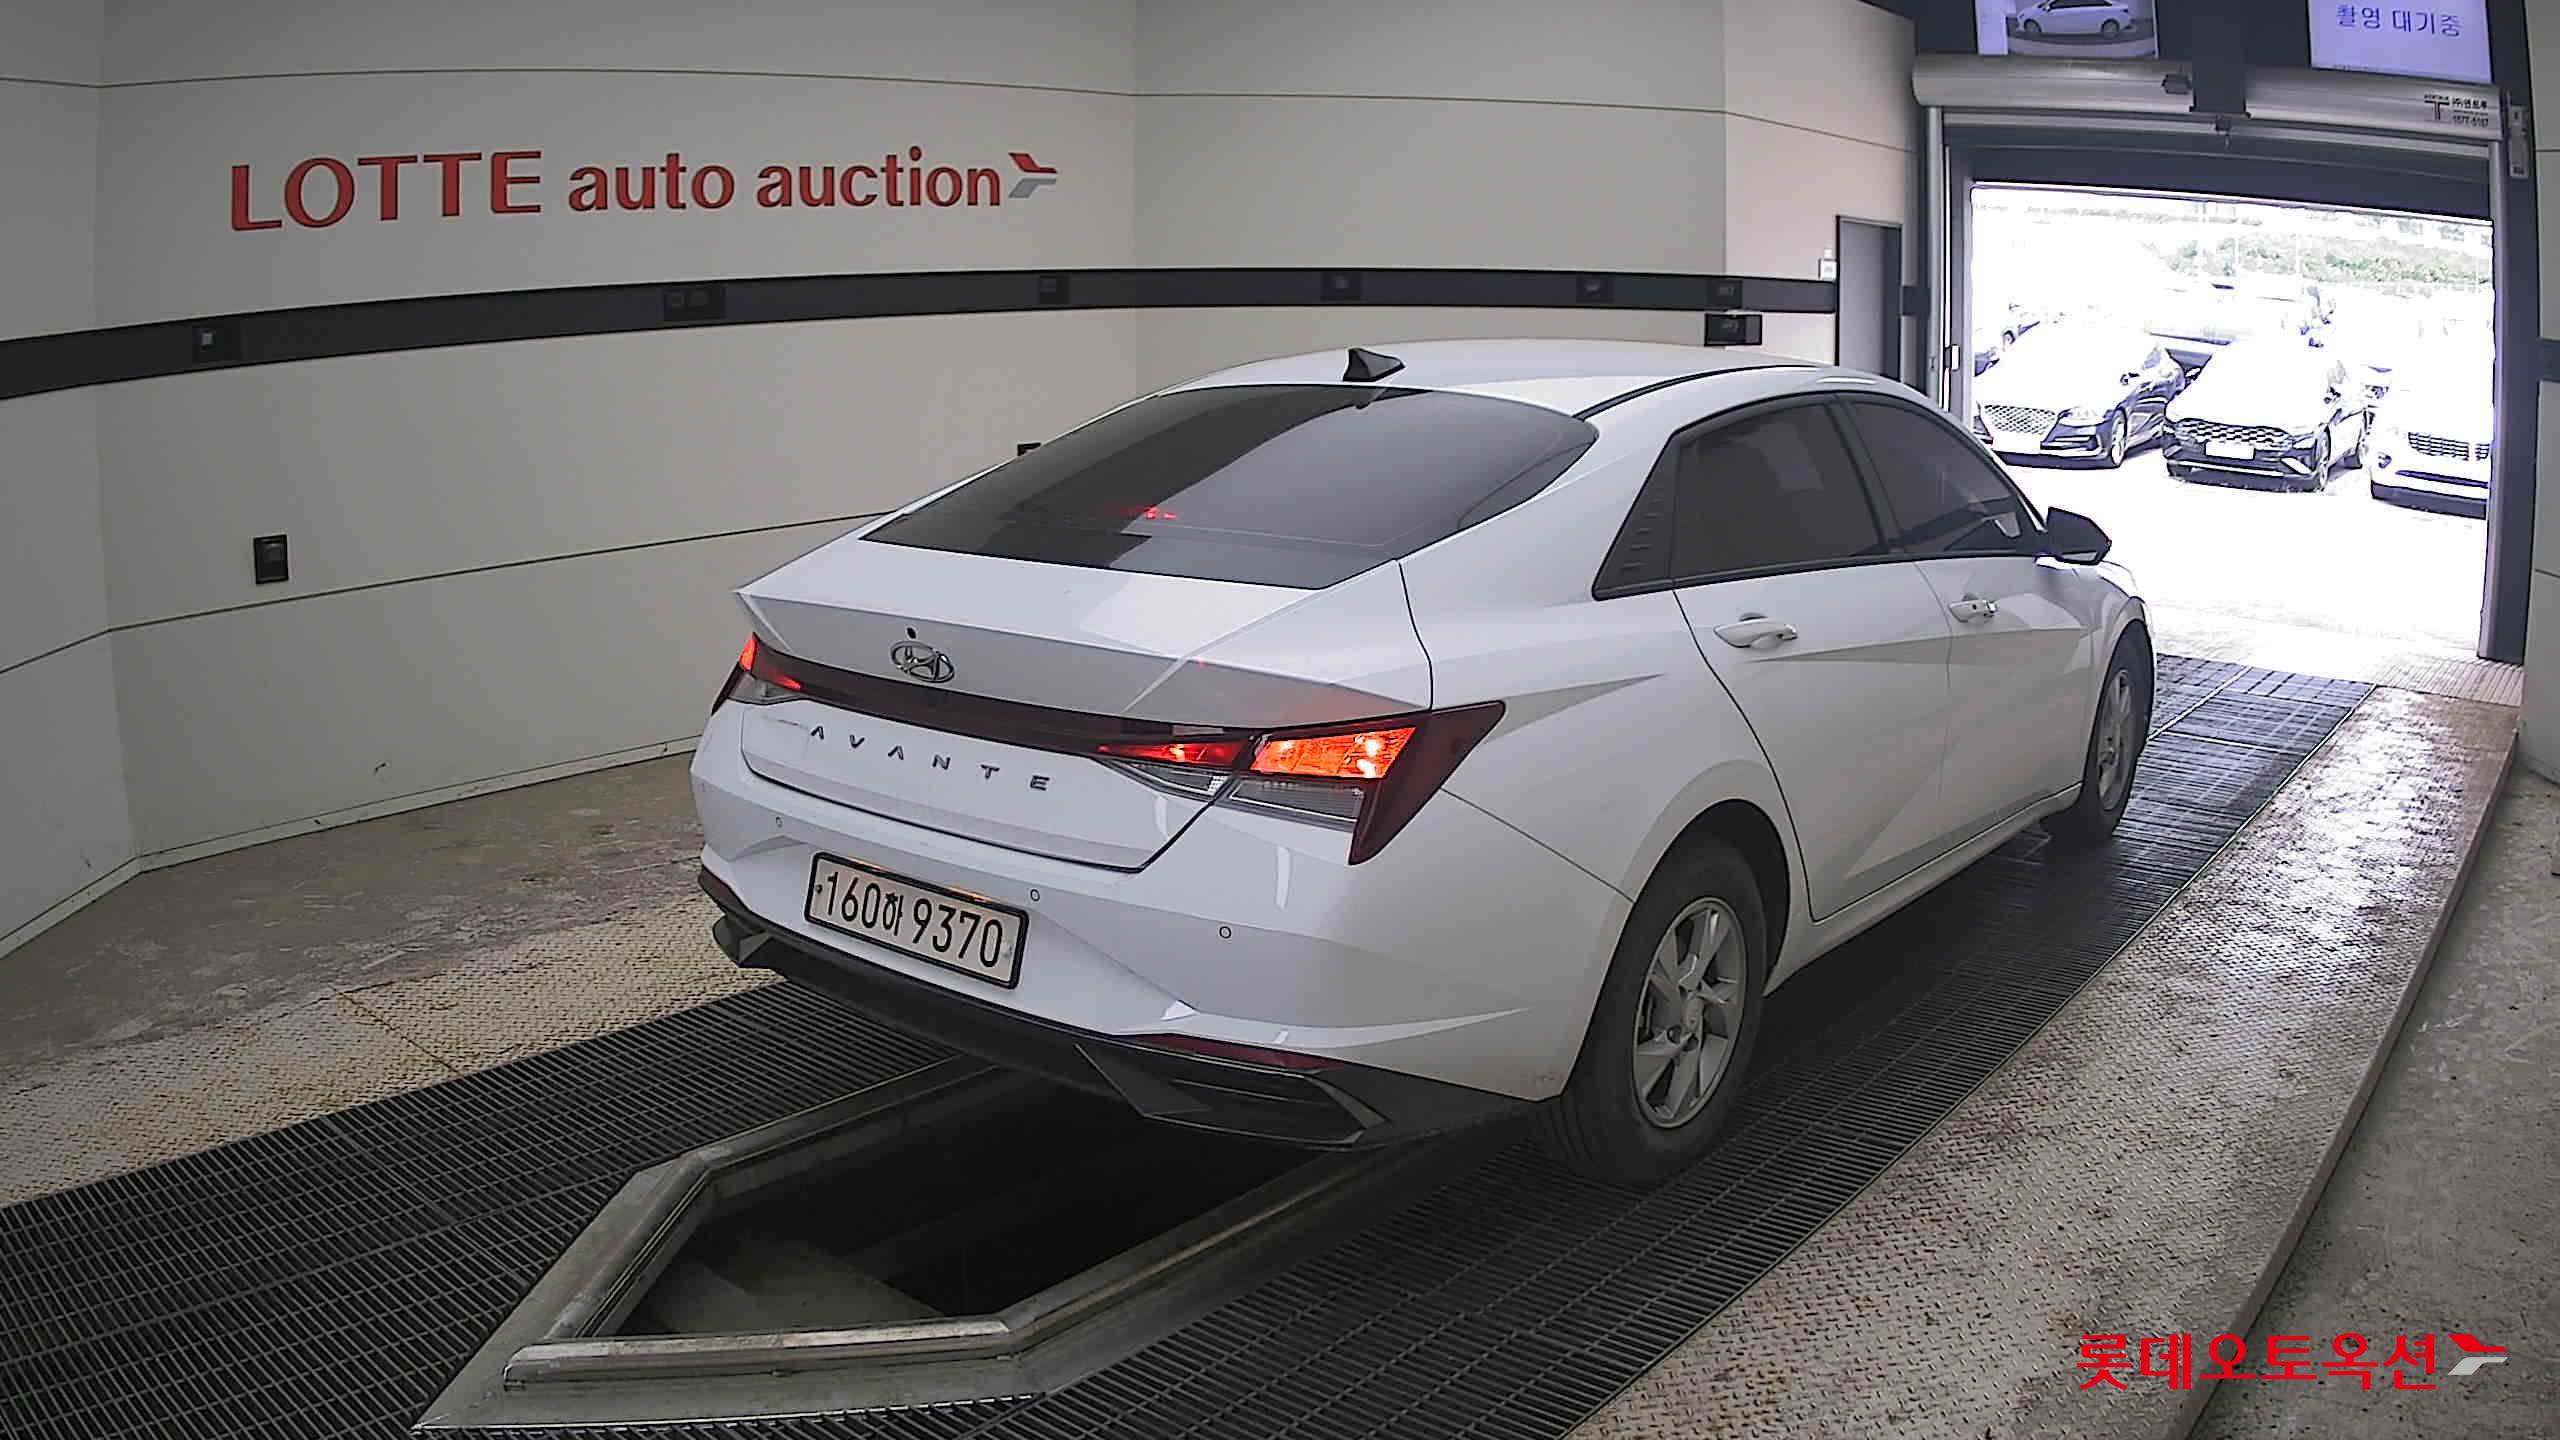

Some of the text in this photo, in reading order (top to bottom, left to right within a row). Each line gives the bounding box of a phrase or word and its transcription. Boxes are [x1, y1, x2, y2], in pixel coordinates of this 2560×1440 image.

[2337, 4, 2463, 37] 촬영 대기중
[231, 146, 1001, 232] LOTTE auto auction
[810, 724, 1051, 792] AVANTE
